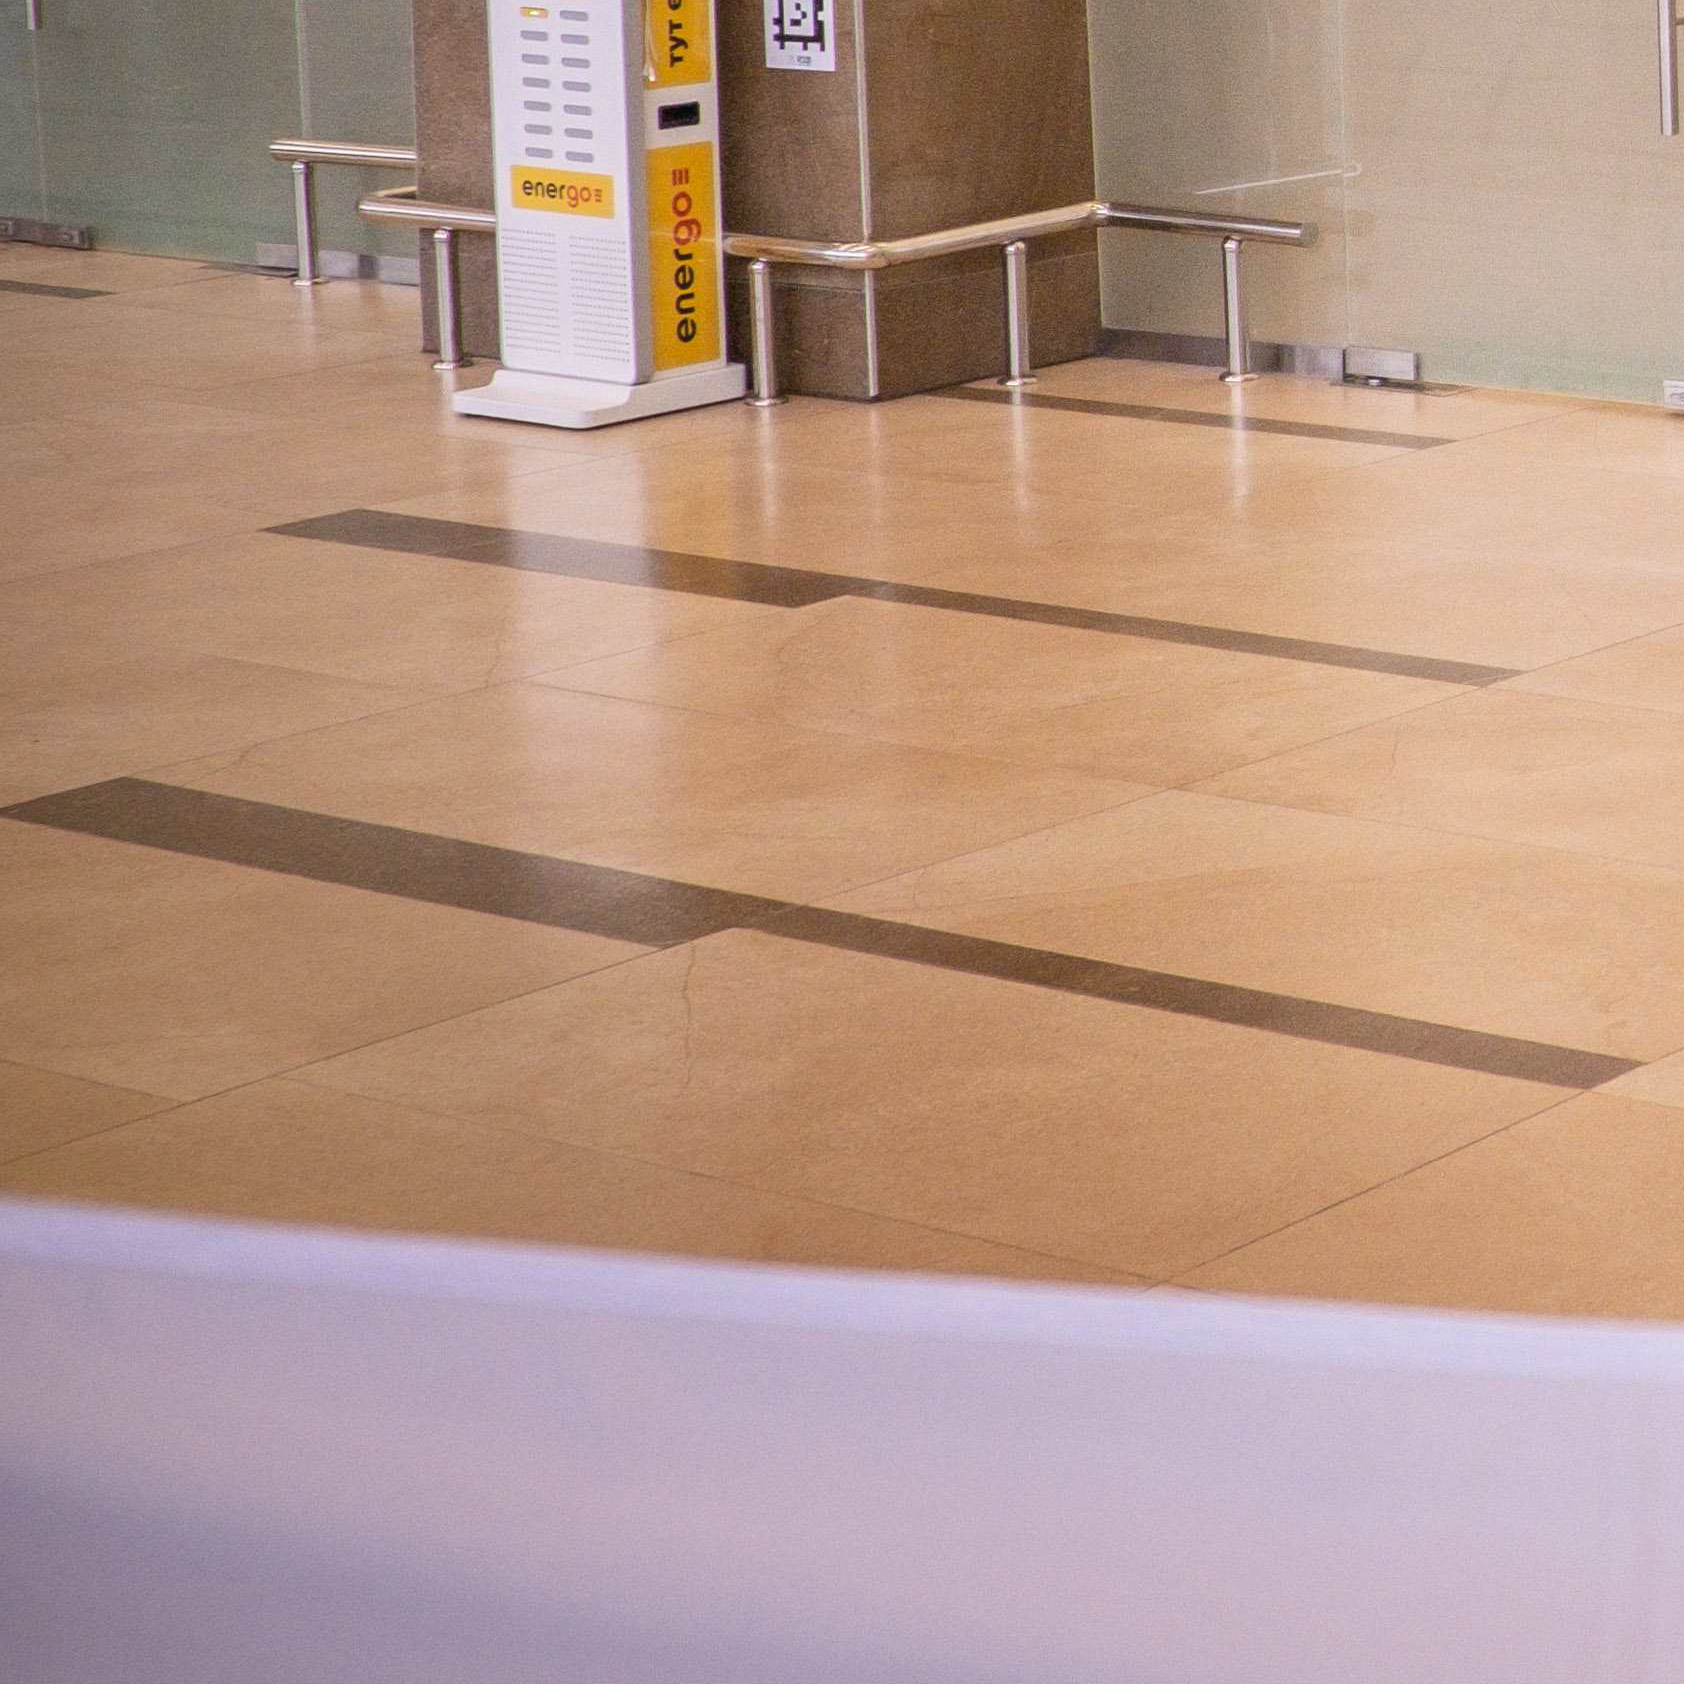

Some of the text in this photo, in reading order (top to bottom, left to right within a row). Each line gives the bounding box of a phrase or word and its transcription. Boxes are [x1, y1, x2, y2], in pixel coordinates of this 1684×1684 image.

[668, 18, 689, 69] тут
[521, 179, 592, 208] energo
[671, 192, 702, 344] energo
